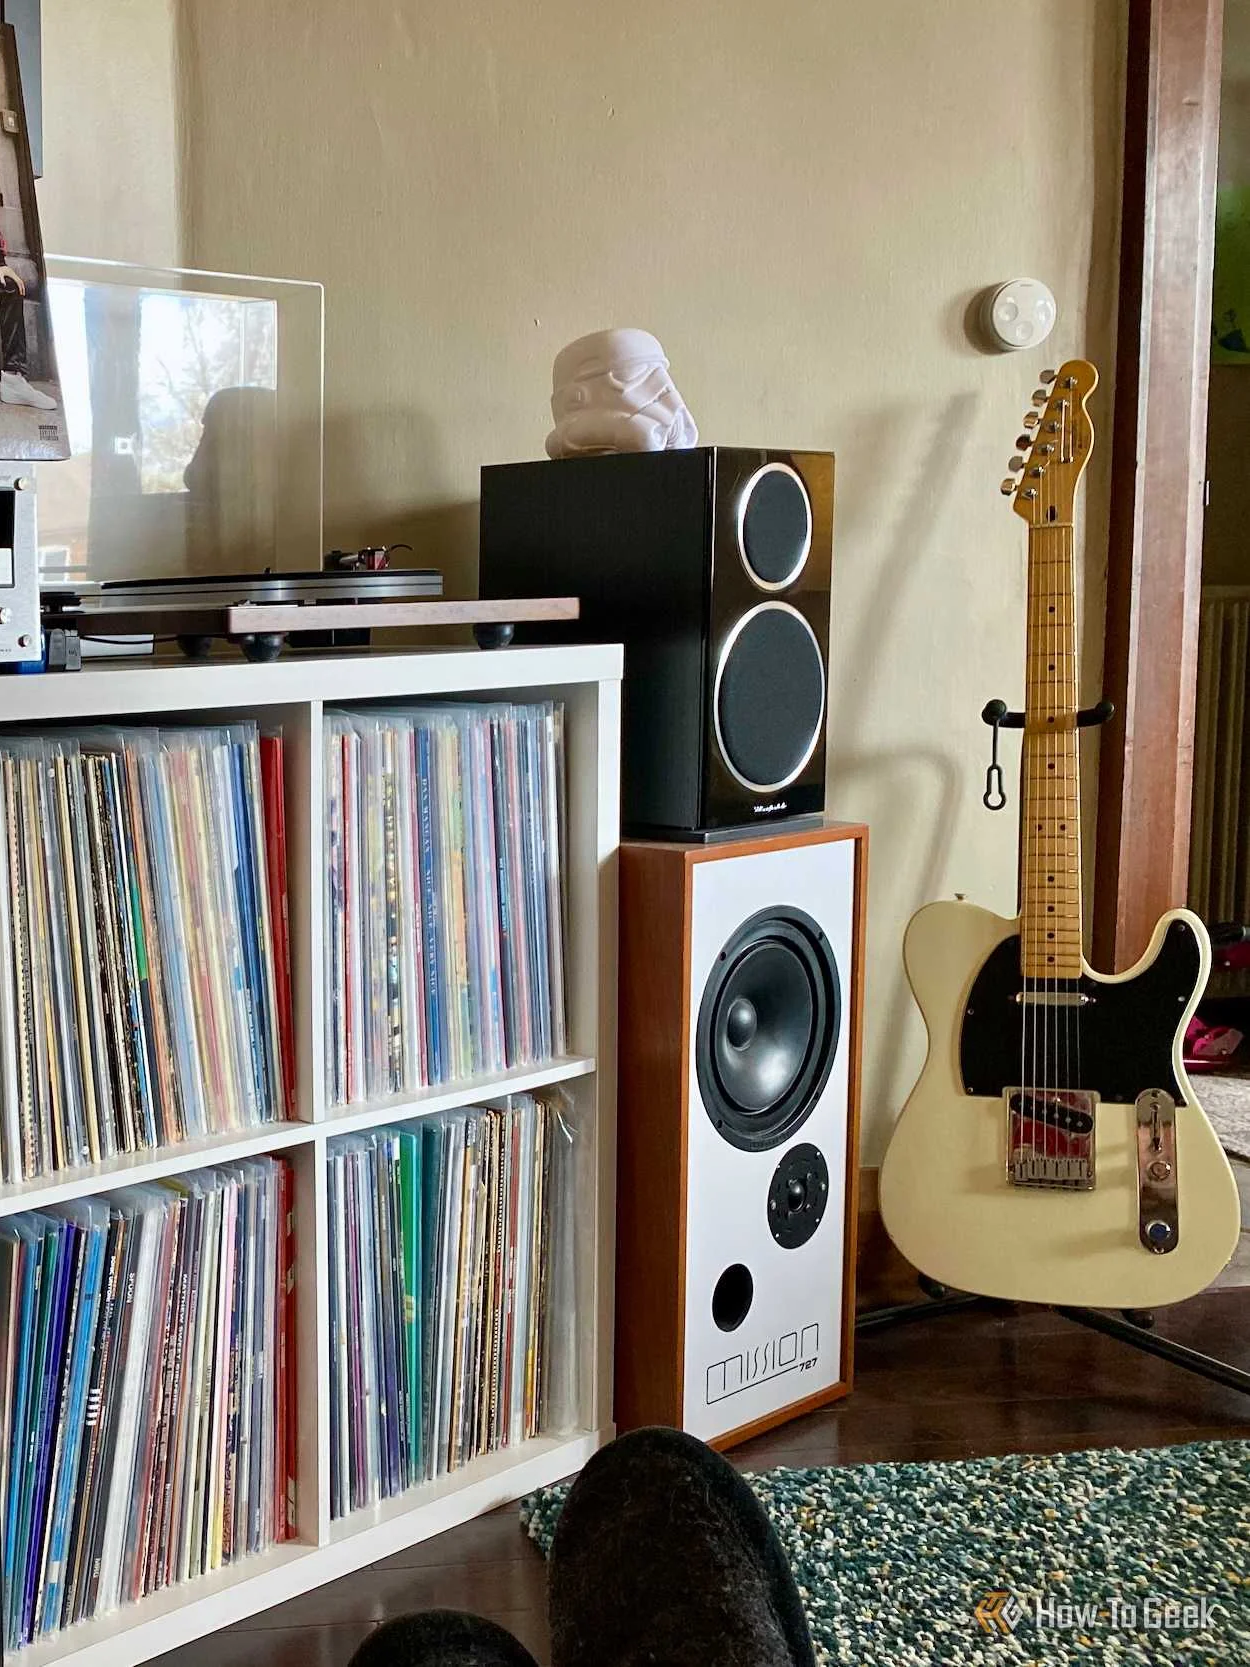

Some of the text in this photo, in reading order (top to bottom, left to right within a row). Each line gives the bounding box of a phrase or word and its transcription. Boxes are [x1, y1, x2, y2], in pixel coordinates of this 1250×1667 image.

[126, 1272, 136, 1303] SPOON
[171, 1273, 189, 1416] MATTHEW SWEET GIRLFRIEND
[800, 1357, 818, 1371] 727
